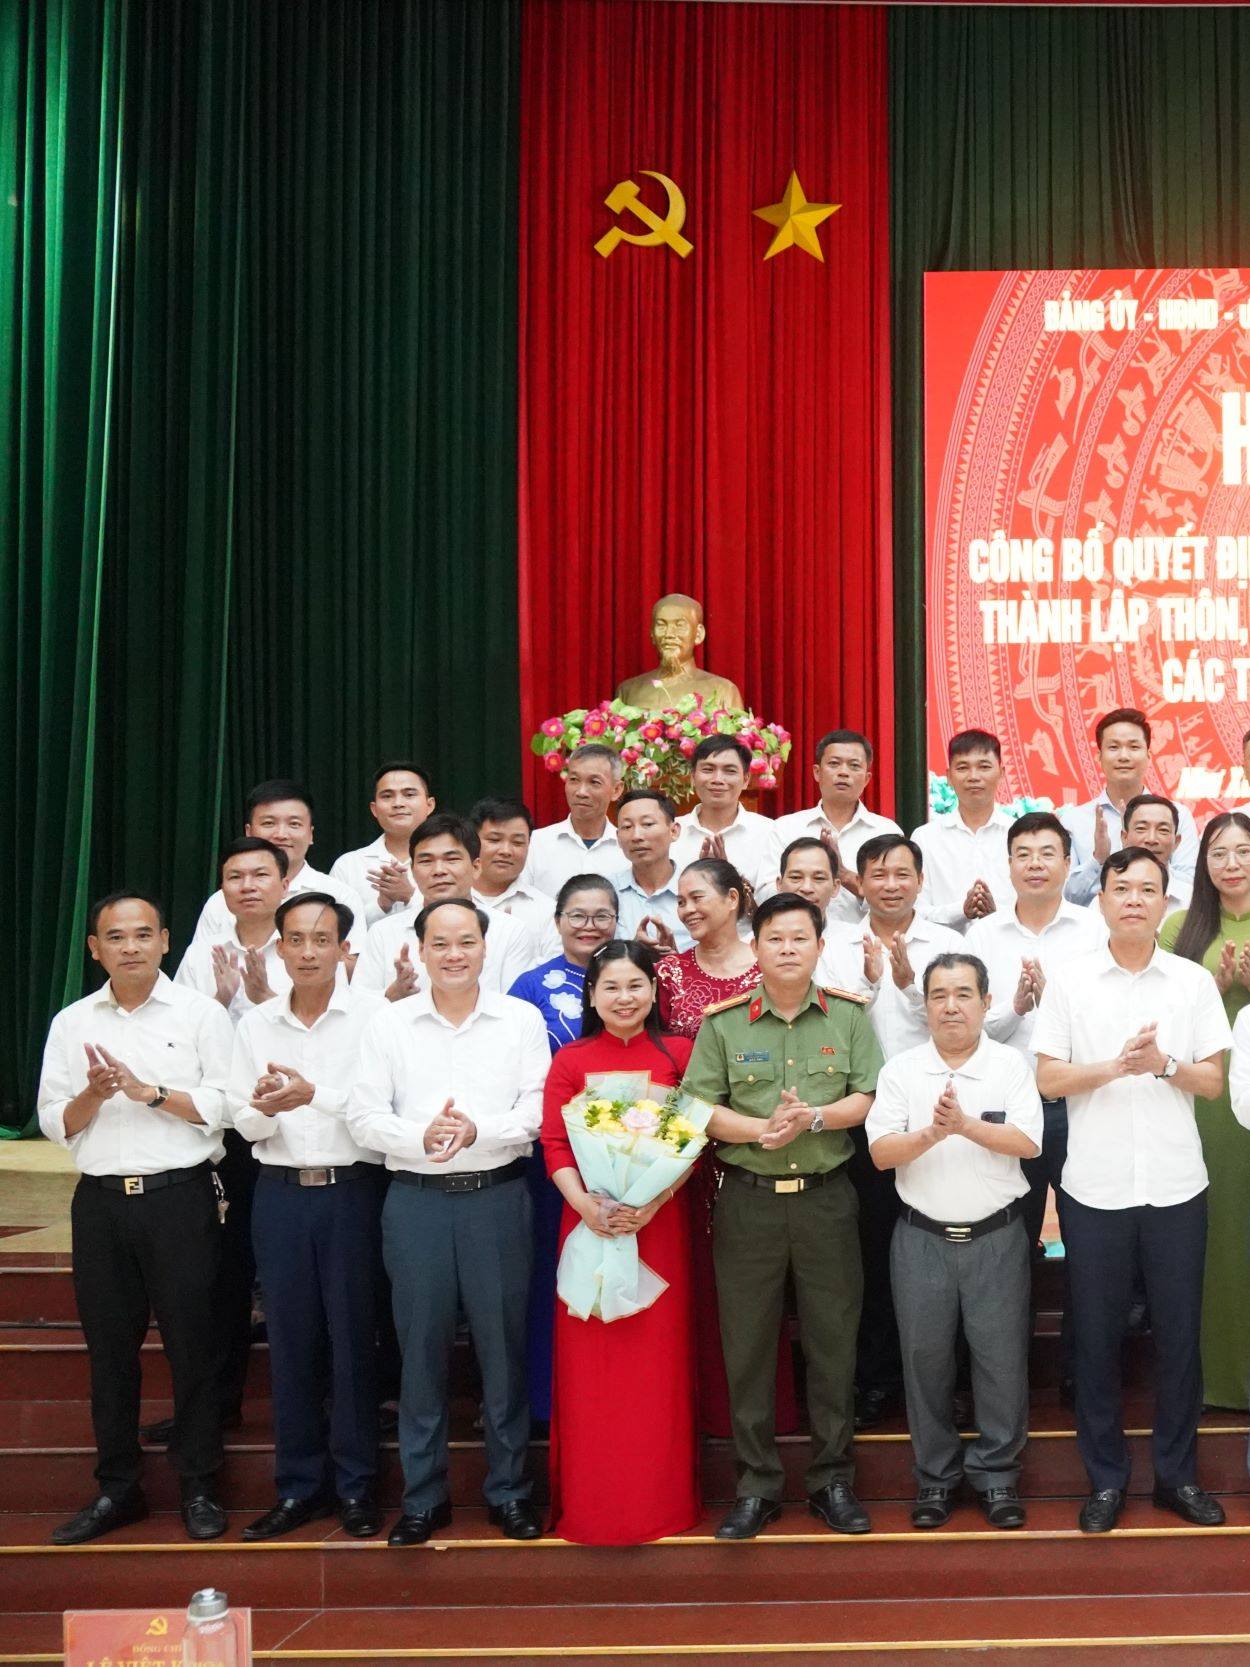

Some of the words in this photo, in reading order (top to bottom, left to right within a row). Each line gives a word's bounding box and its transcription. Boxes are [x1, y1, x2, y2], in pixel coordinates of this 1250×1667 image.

[1109, 290, 1139, 331] ỦY
[968, 529, 1054, 584] CÔNG
[1062, 521, 1105, 582] BỐ
[1113, 522, 1209, 586] QUYẾT
[979, 590, 1082, 644] THÀNH
[1090, 588, 1150, 653] LẬP
[1155, 586, 1249, 647] THÔN,
[1162, 649, 1225, 703] CÁC
